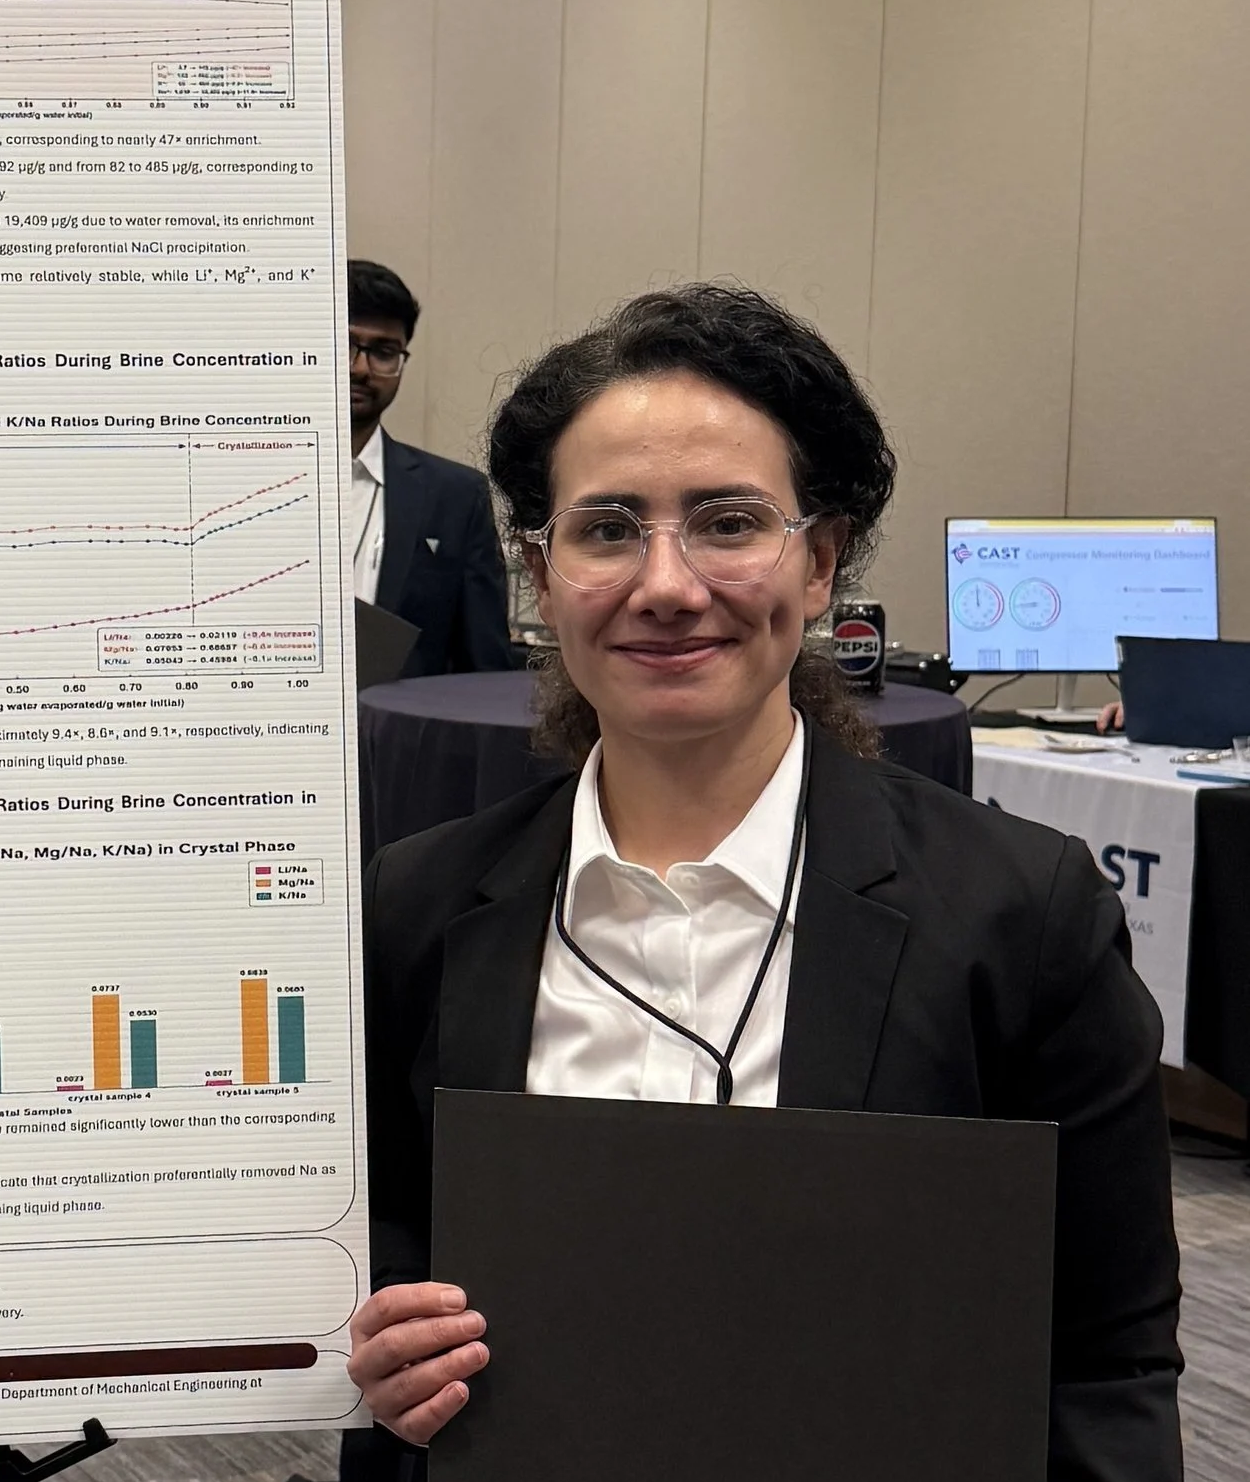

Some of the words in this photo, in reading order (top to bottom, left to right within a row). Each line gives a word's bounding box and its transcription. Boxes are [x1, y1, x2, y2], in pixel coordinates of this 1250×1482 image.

[55, 353, 112, 371] During
[120, 353, 164, 367] Brine
[172, 352, 294, 367] Concentration
[302, 351, 317, 366] in
[977, 547, 1021, 560] CAST
[834, 640, 878, 653] PEPSI
[1102, 844, 1161, 898] ST
[1130, 920, 1154, 934] XAS
